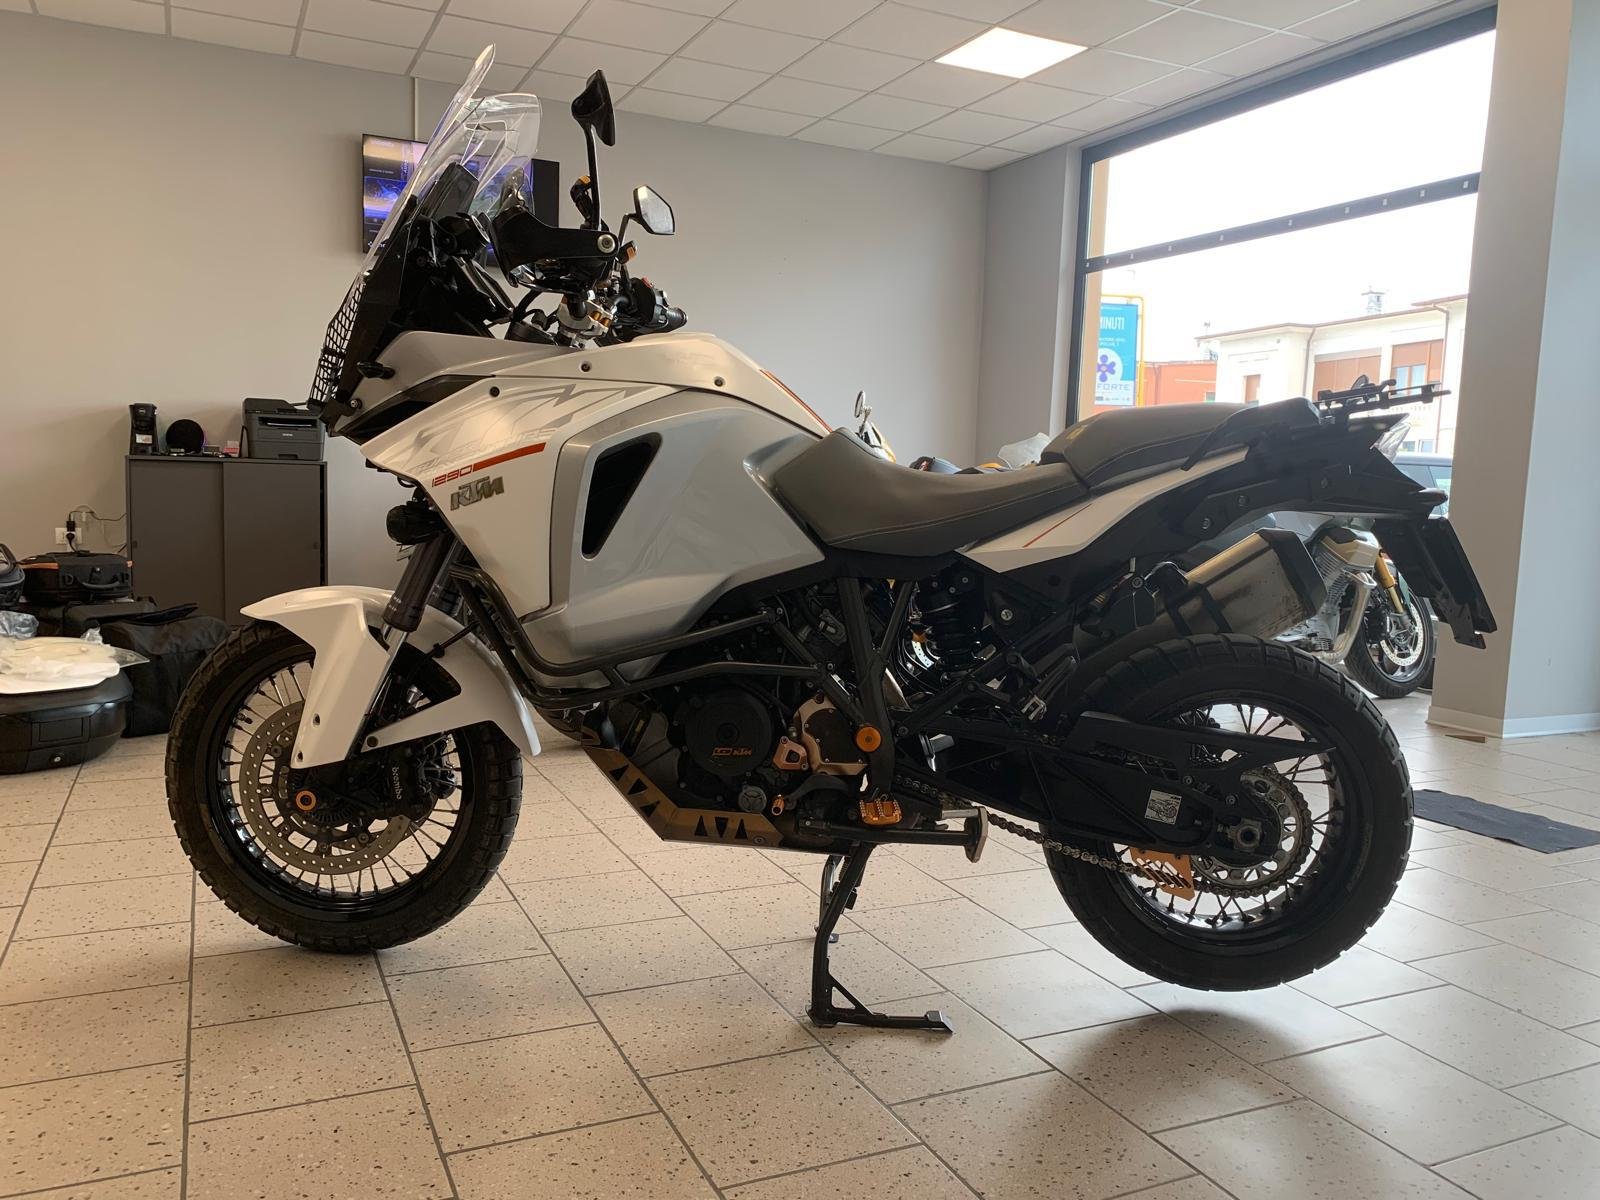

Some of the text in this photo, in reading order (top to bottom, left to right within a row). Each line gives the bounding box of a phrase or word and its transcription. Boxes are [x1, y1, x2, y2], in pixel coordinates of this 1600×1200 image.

[432, 464, 473, 488] 1290
[451, 476, 505, 511] KTM
[392, 766, 403, 800] brembo
